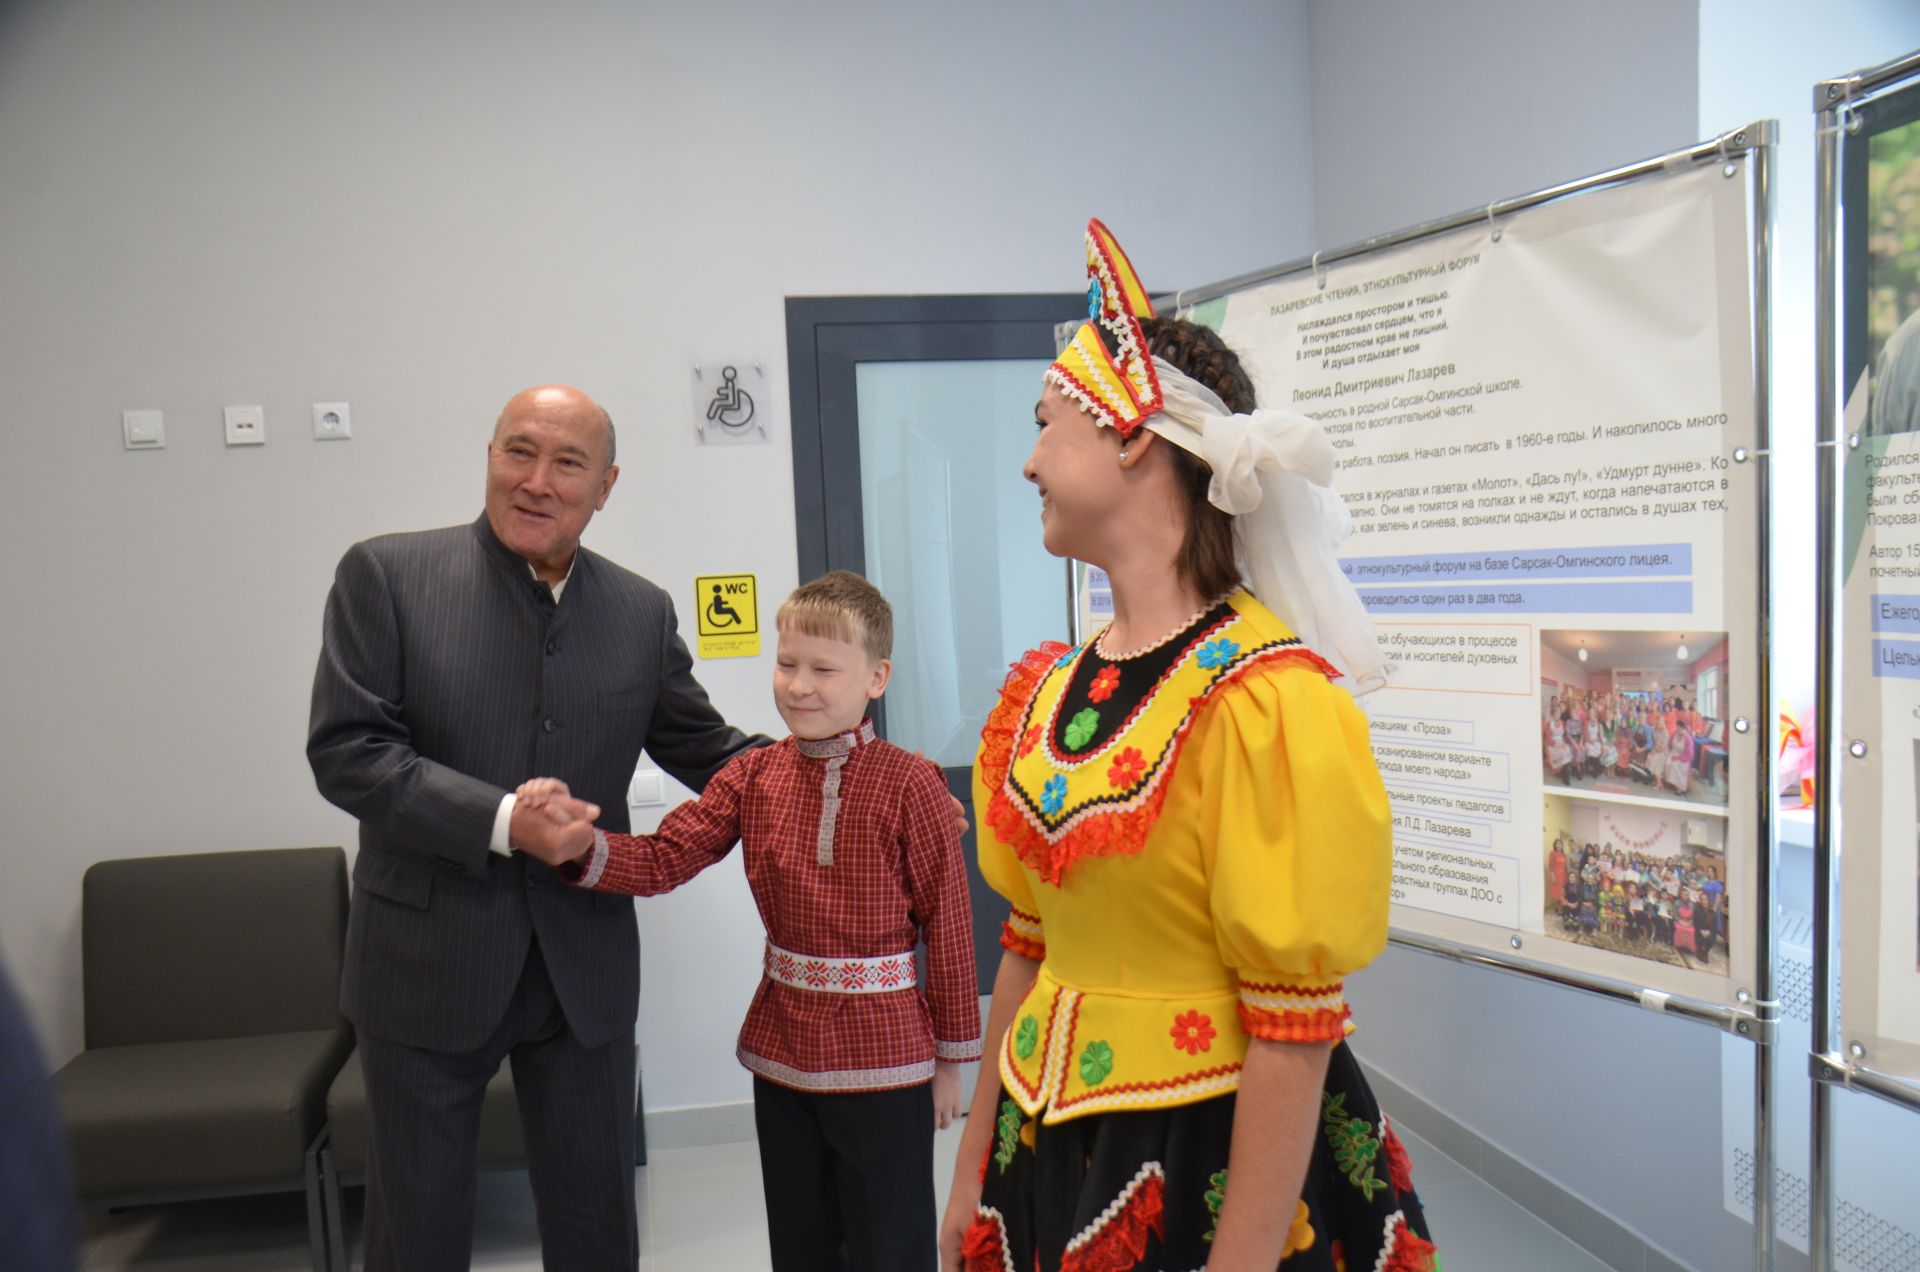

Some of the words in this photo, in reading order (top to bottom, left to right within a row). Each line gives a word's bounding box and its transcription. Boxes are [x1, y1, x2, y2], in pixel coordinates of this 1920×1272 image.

[1270, 294, 1324, 316] ЛАЗАРЕВСКИЕ
[1363, 262, 1446, 294] ЭТНОКУЛЬТУРНЫЙ
[1448, 253, 1480, 272] ФОРУМ
[1355, 303, 1405, 322] простором
[1407, 299, 1414, 309] и
[1302, 334, 1309, 345] И
[1309, 324, 1373, 344] почувствовал
[1375, 314, 1417, 332] сердцем,
[1419, 310, 1432, 321] что
[1434, 307, 1442, 317] я
[1303, 348, 1323, 360] этом
[1325, 338, 1374, 360] радостном
[1376, 334, 1397, 345] крае
[1399, 330, 1411, 340] не
[1323, 358, 1329, 370] И
[1331, 354, 1356, 370] душа
[1358, 346, 1401, 364] отдыхает
[1403, 343, 1420, 355] моя
[1292, 385, 1332, 402] Леонид
[1334, 372, 1405, 397] Дмитриевич
[1407, 363, 1456, 384] Лазарев
[1350, 406, 1355, 416] в
[1357, 398, 1390, 415] родной
[1392, 386, 1483, 409] Сарсак-Омгинской
[1485, 377, 1523, 394] школе.
[1355, 421, 1366, 430] по
[1368, 406, 1442, 428] воспитательной
[1444, 403, 1476, 418] части.
[1414, 447, 1446, 459] Начал
[1448, 445, 1462, 456] он
[1464, 442, 1500, 455] писать
[1506, 438, 1512, 449] в
[1516, 433, 1554, 448] 1960-е
[1557, 430, 1588, 446] годы.
[1592, 425, 1602, 439] И
[1606, 421, 1682, 438] накопилось
[1686, 412, 1728, 428] много
[1865, 453, 1919, 468] Родился
[1367, 491, 1372, 501] в
[1374, 486, 1420, 503] журналах
[1423, 485, 1429, 495] и
[1432, 480, 1468, 495] газетах
[1596, 464, 1649, 482] «Удмурт
[1711, 456, 1729, 470] Ко
[1381, 503, 1400, 516] Они
[1403, 503, 1414, 514] не
[1418, 500, 1458, 513] томятся
[1461, 499, 1474, 509] на
[1478, 495, 1515, 509] полках
[1519, 495, 1526, 505] и
[1530, 493, 1544, 504] не
[1583, 487, 1616, 501] когда
[1621, 480, 1715, 497] напечатаются
[1720, 479, 1729, 490] в
[1866, 493, 1897, 507] были
[1903, 489, 1920, 504] сб
[1360, 523, 1375, 534] как
[1377, 520, 1409, 532] зелень
[1412, 519, 1418, 529] и
[1421, 516, 1458, 529] синева,
[1462, 512, 1511, 526] возникли
[1514, 509, 1566, 524] однажды
[1570, 509, 1577, 519] и
[1580, 504, 1638, 519] остались
[1642, 504, 1650, 515] в
[1653, 500, 1697, 517] душах
[1703, 498, 1728, 512] тех,
[1869, 544, 1902, 561] Автор
[1358, 560, 1430, 576] этнокультурный
[1433, 558, 1466, 575] форум
[1469, 560, 1482, 571] на
[1484, 557, 1509, 570] базе
[1511, 554, 1626, 571] Сарсак-Омгинского
[1629, 553, 1672, 567] лицея.
[725, 582, 748, 594] WC
[1422, 594, 1445, 605] один
[1448, 594, 1465, 606] раз
[1467, 594, 1474, 604] в
[1476, 593, 1495, 605] два
[1498, 592, 1525, 605] года.
[1881, 603, 1920, 620] Ежего
[1391, 632, 1456, 648] обучающихся
[1459, 636, 1465, 646] в
[1468, 636, 1517, 649] процессе
[1405, 652, 1411, 661] и
[1414, 651, 1464, 663] носителей
[1467, 653, 1517, 666] духовных
[1377, 746, 1445, 761] сканированном
[1448, 752, 1492, 766] варианте
[1404, 764, 1431, 776] моего
[1433, 766, 1472, 780] народа»
[1416, 793, 1453, 808] проекты
[1455, 799, 1504, 815] педагогов
[1425, 820, 1471, 838] Лазарева
[1394, 845, 1423, 858] учетом
[1428, 864, 1489, 885] образования
[1432, 881, 1468, 896] группах
[1470, 887, 1494, 902] ДОО
[1497, 894, 1503, 904] с
